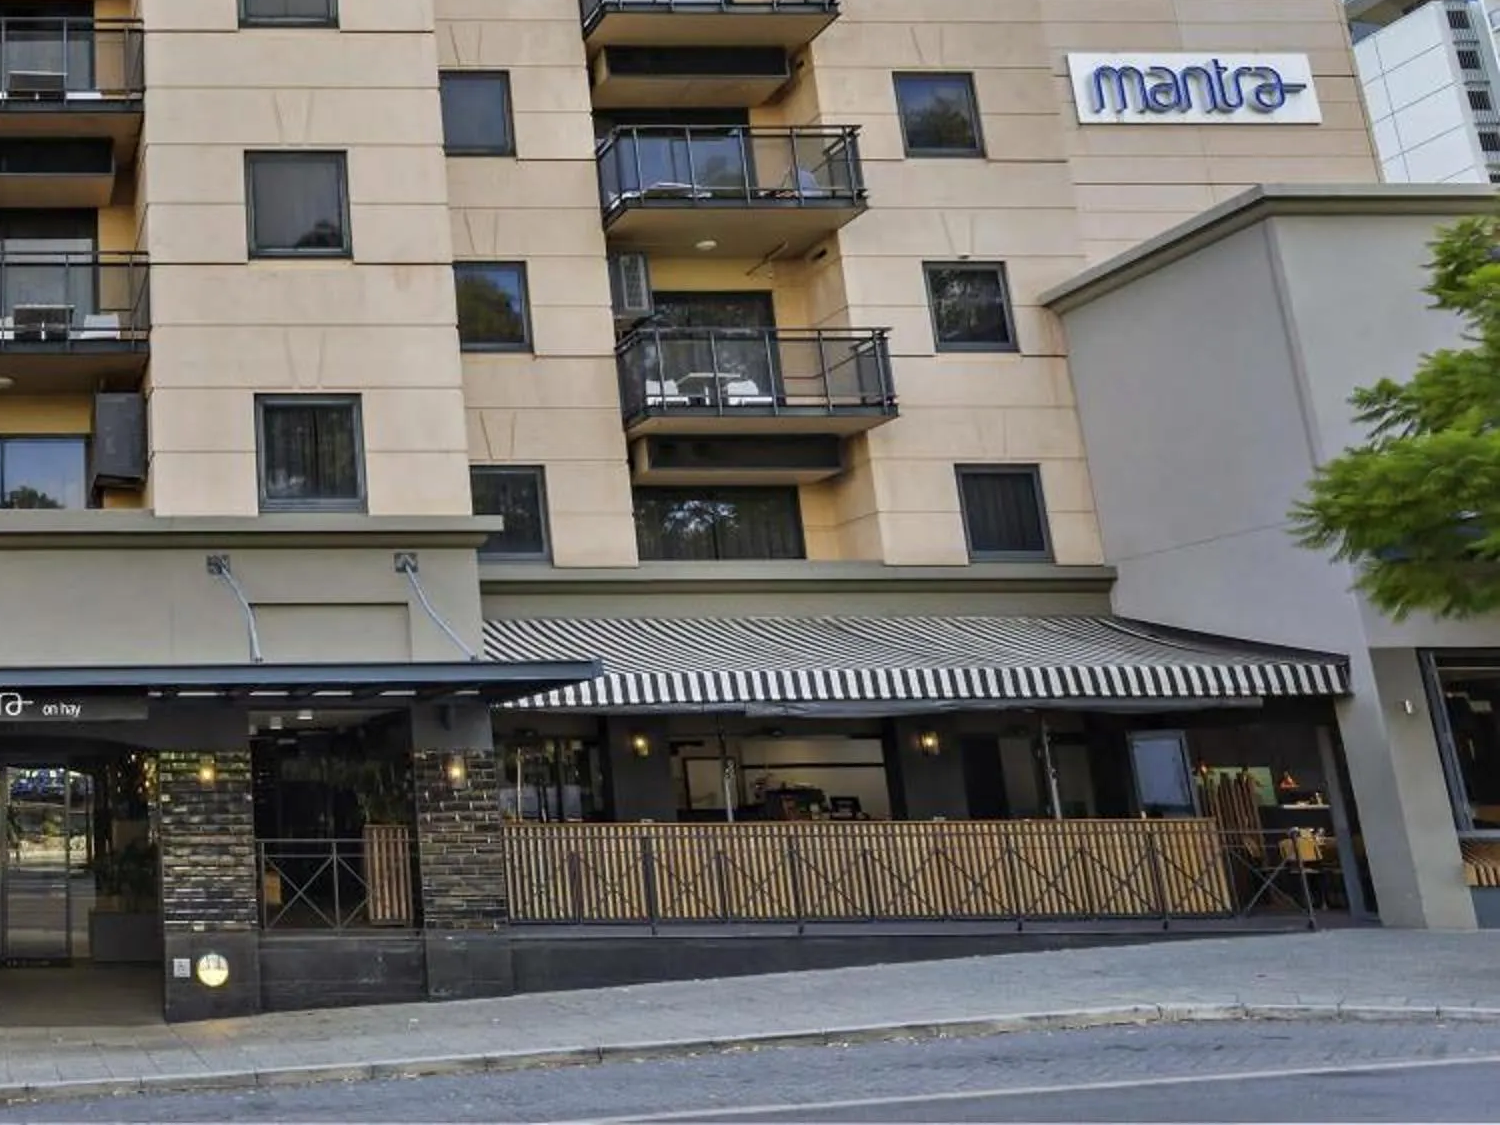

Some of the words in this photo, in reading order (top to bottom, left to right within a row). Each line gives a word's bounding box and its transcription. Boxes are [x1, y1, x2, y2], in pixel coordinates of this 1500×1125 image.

[1091, 58, 1307, 114] mantra
[43, 704, 58, 716] on
[60, 703, 81, 718] hay
